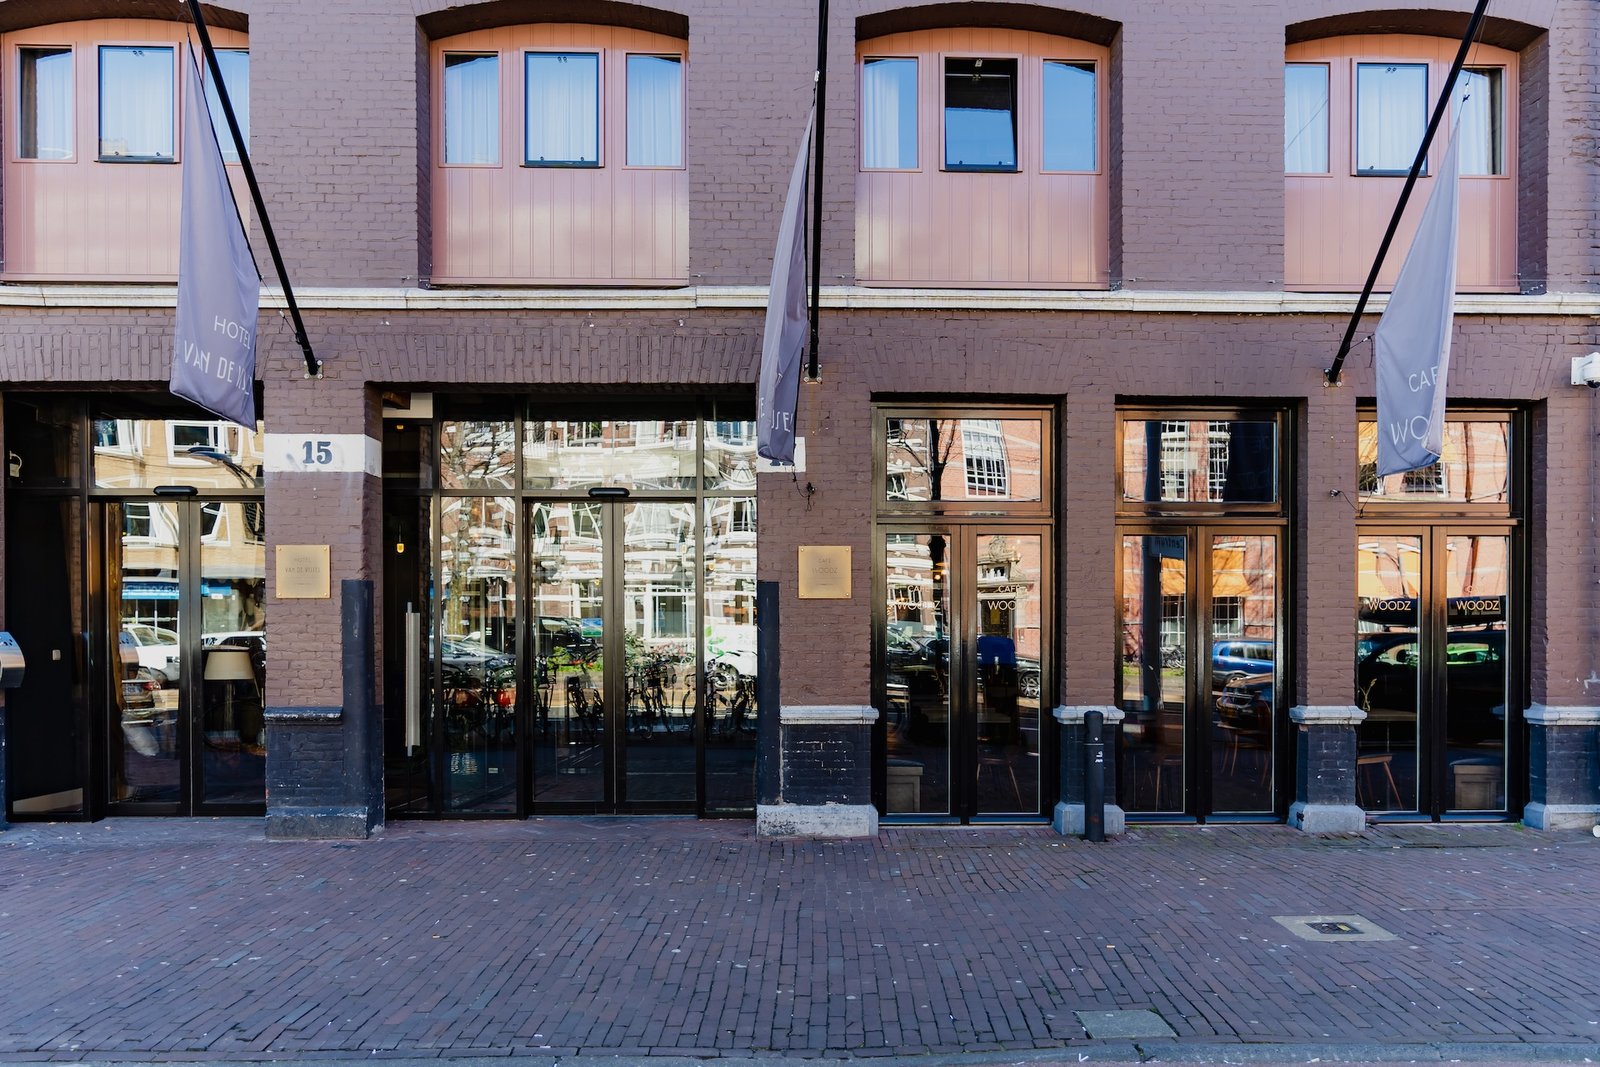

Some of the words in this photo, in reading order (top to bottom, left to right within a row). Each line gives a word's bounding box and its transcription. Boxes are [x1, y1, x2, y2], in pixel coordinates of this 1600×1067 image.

[184, 340, 210, 374] VAN
[217, 356, 235, 383] DE
[1408, 365, 1438, 392] CAF
[1390, 415, 1429, 446] WO
[302, 441, 333, 464] 15
[987, 600, 1019, 611] WOO
[1368, 600, 1412, 611] WOODZ
[1456, 600, 1500, 611] WOODZ
